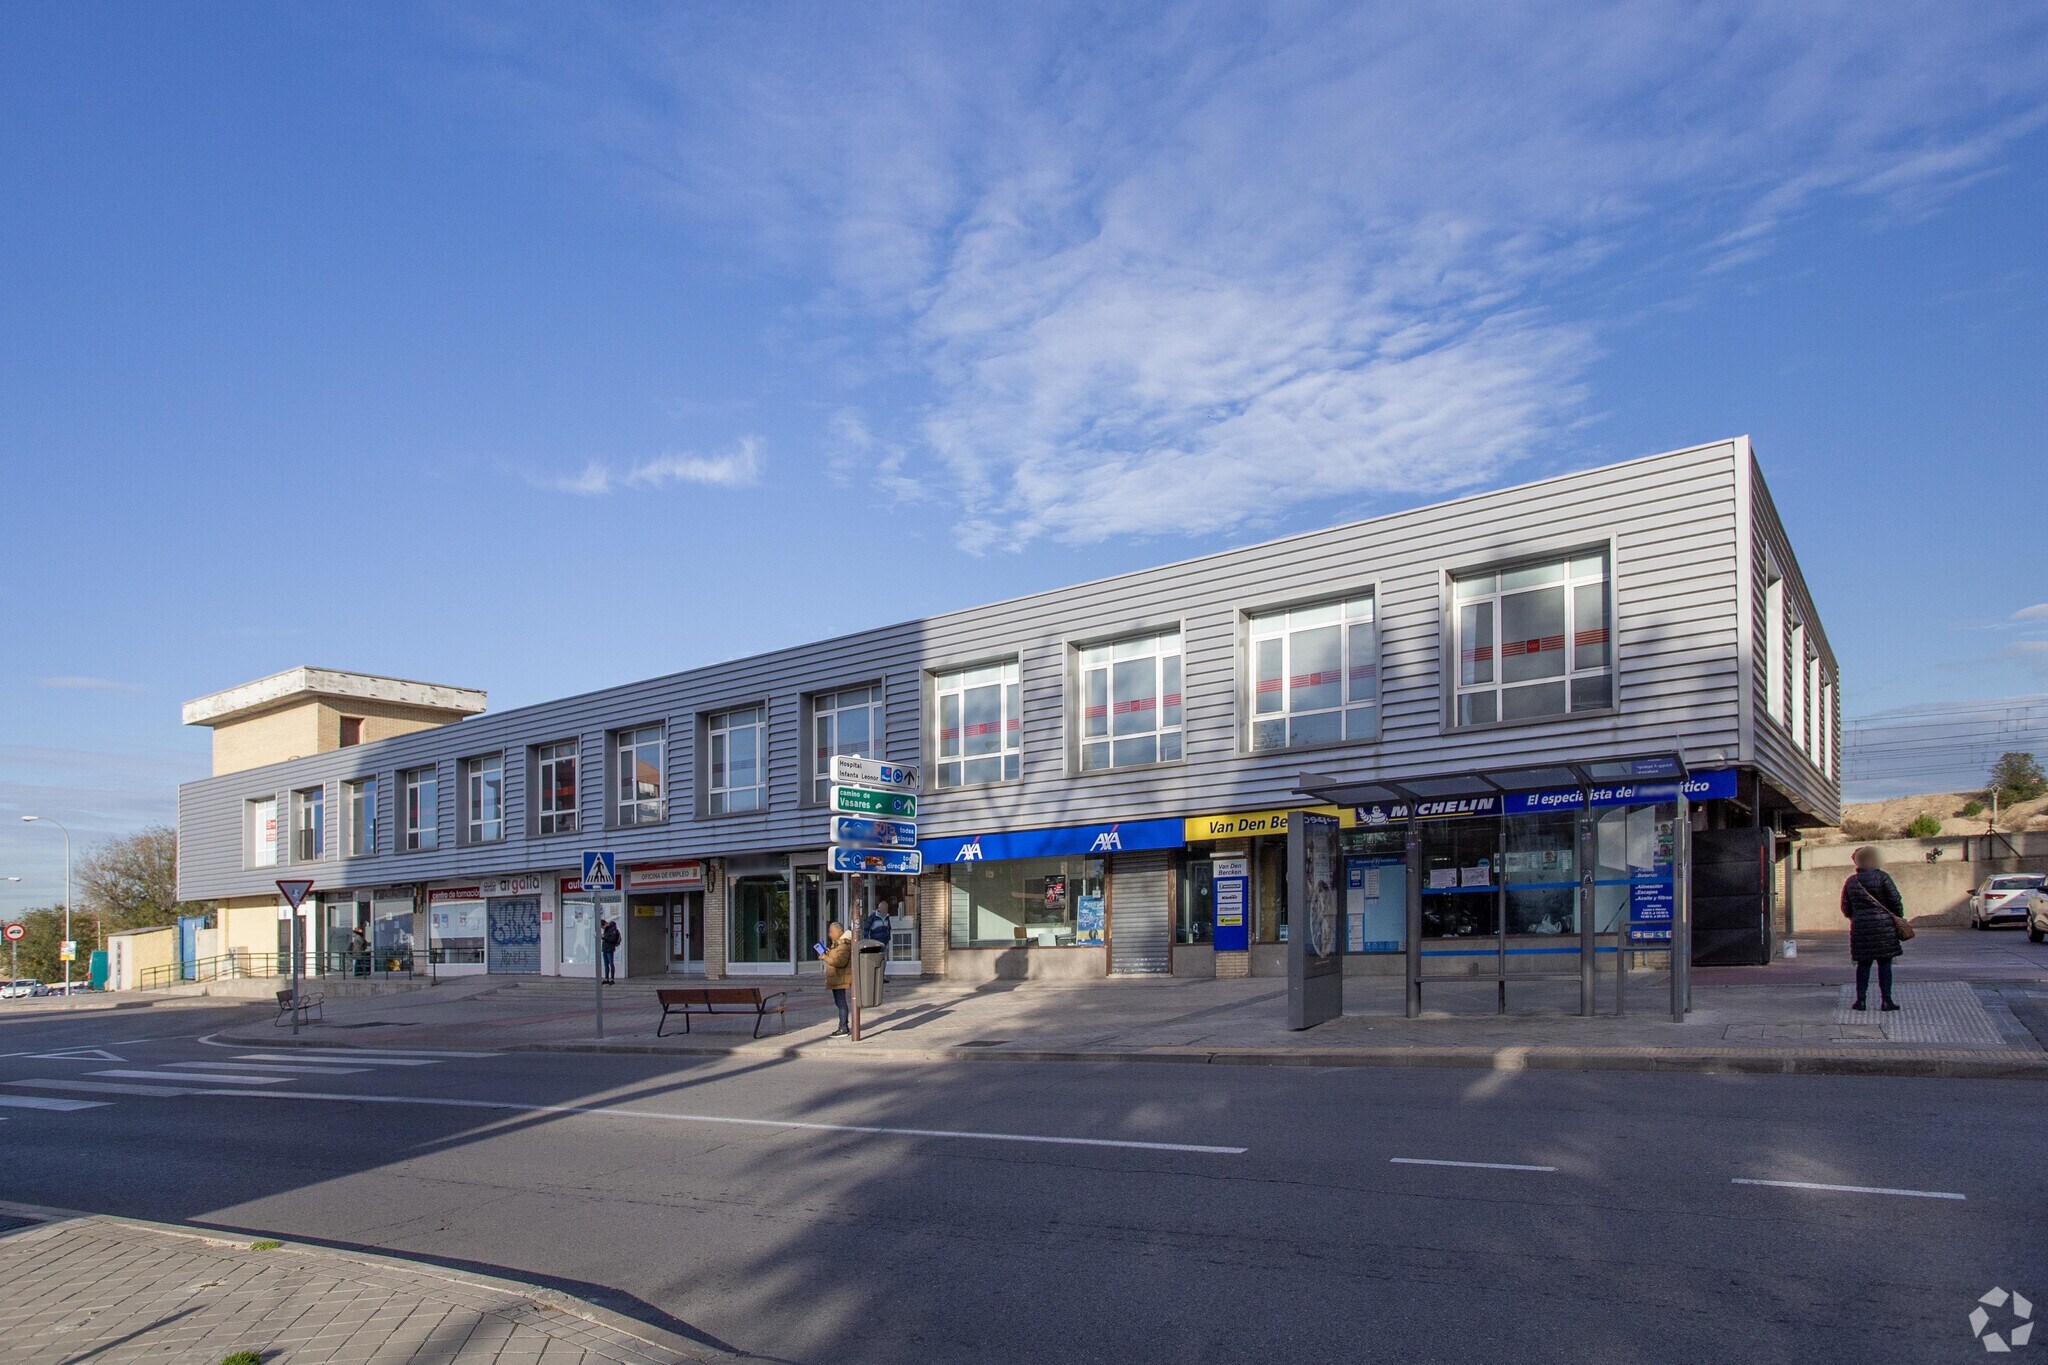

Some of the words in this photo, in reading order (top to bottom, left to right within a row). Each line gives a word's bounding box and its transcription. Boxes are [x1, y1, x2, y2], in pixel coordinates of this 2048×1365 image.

[840, 761, 862, 769] Hospital
[840, 771, 858, 779] Infanta
[840, 790, 860, 798] camino
[1527, 794, 1539, 806] El
[1541, 788, 1612, 807] especiaista
[840, 798, 870, 809] Vasares
[1391, 798, 1494, 817] MCHELIN
[1210, 821, 1233, 834] Van
[1238, 818, 1266, 831] Den
[1090, 824, 1122, 852] AXA
[955, 836, 983, 861] AXA
[500, 875, 539, 894] argalia
